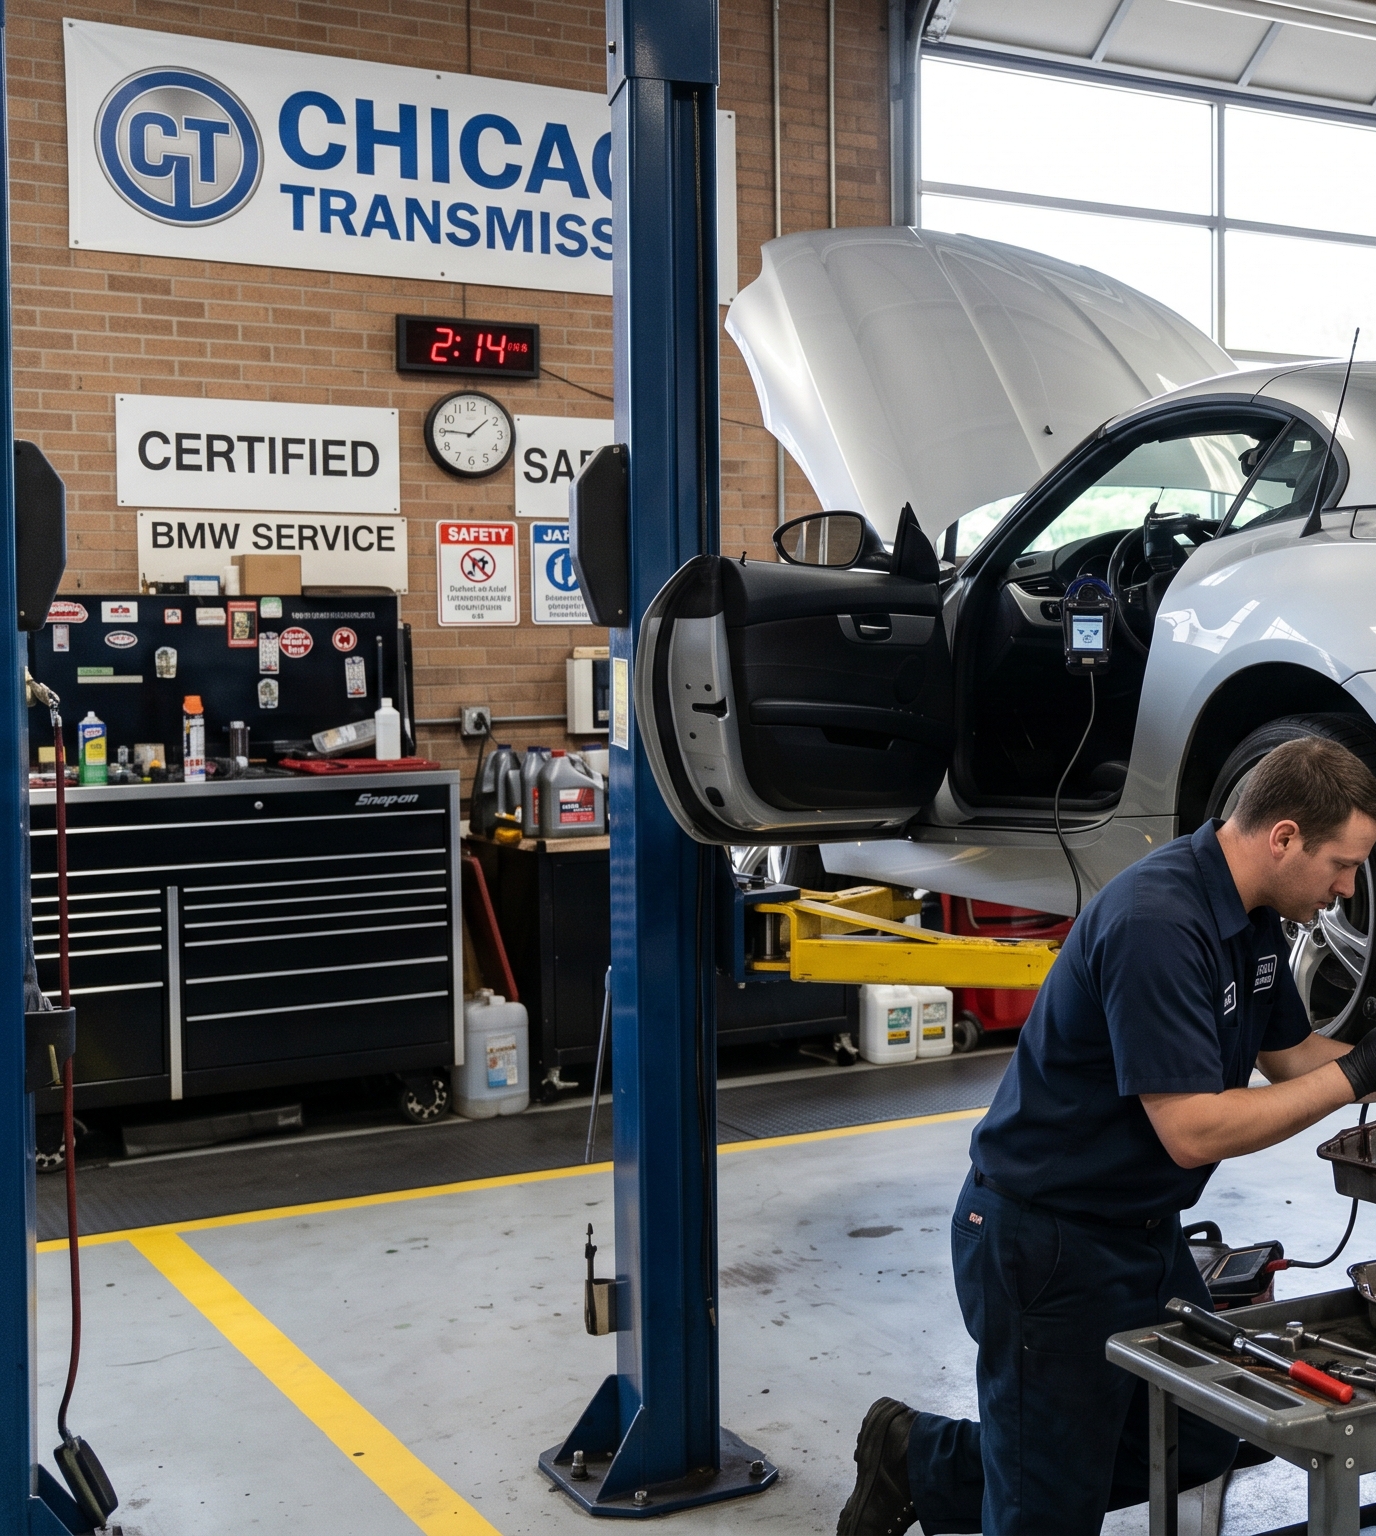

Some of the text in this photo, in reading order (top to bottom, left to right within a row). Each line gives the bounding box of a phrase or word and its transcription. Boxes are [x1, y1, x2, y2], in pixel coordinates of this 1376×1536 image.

[430, 327, 507, 364] 2:14
[454, 403, 462, 414] 11
[467, 401, 476, 412] 12
[444, 414, 455, 424] 10
[491, 416, 499, 427] 2
[438, 427, 446, 437] 9
[496, 430, 504, 440] 3
[443, 441, 451, 451] 8
[491, 443, 499, 452] 4
[138, 430, 380, 478] CERTIFIED
[454, 451, 462, 462] 7
[482, 453, 490, 463] 5
[467, 455, 475, 466] 6
[151, 521, 396, 552] BMW SERVICE
[448, 526, 509, 542] SAFETY
[355, 793, 419, 808] Snap-on
